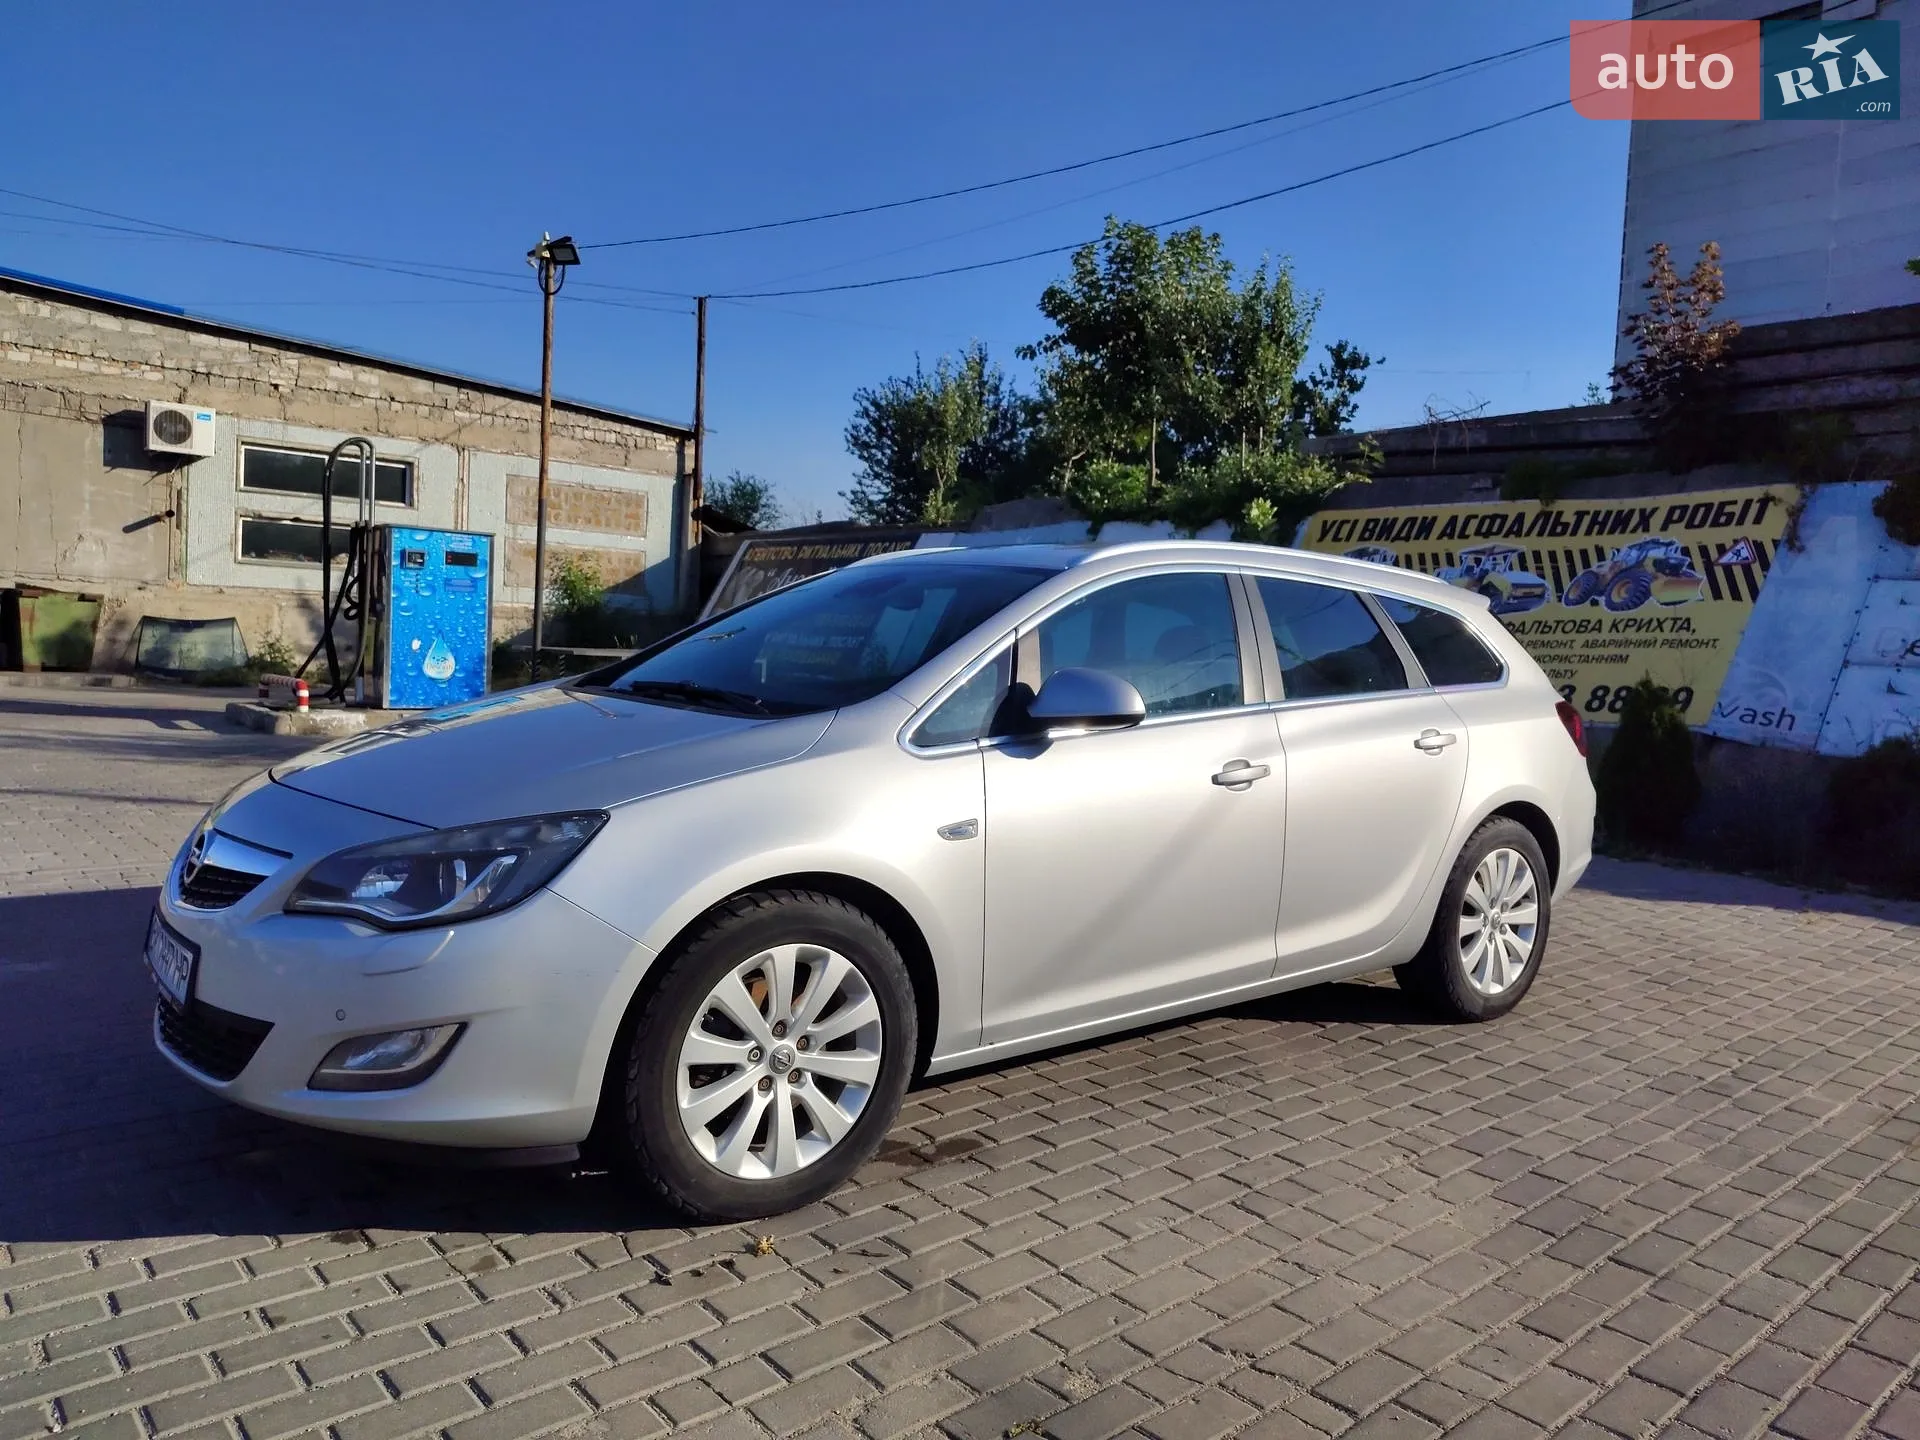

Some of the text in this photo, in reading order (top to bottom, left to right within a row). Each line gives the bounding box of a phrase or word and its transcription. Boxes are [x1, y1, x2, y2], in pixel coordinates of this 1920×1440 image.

[1316, 497, 1774, 543] УСІ ВИДИ АСФАЛЬТНИХ РОБІТ
[1608, 616, 1697, 636] КРИХТА,
[1580, 637, 1658, 649] АВАРІЙНИЙ
[1659, 637, 1721, 650] РЕМОНТ,
